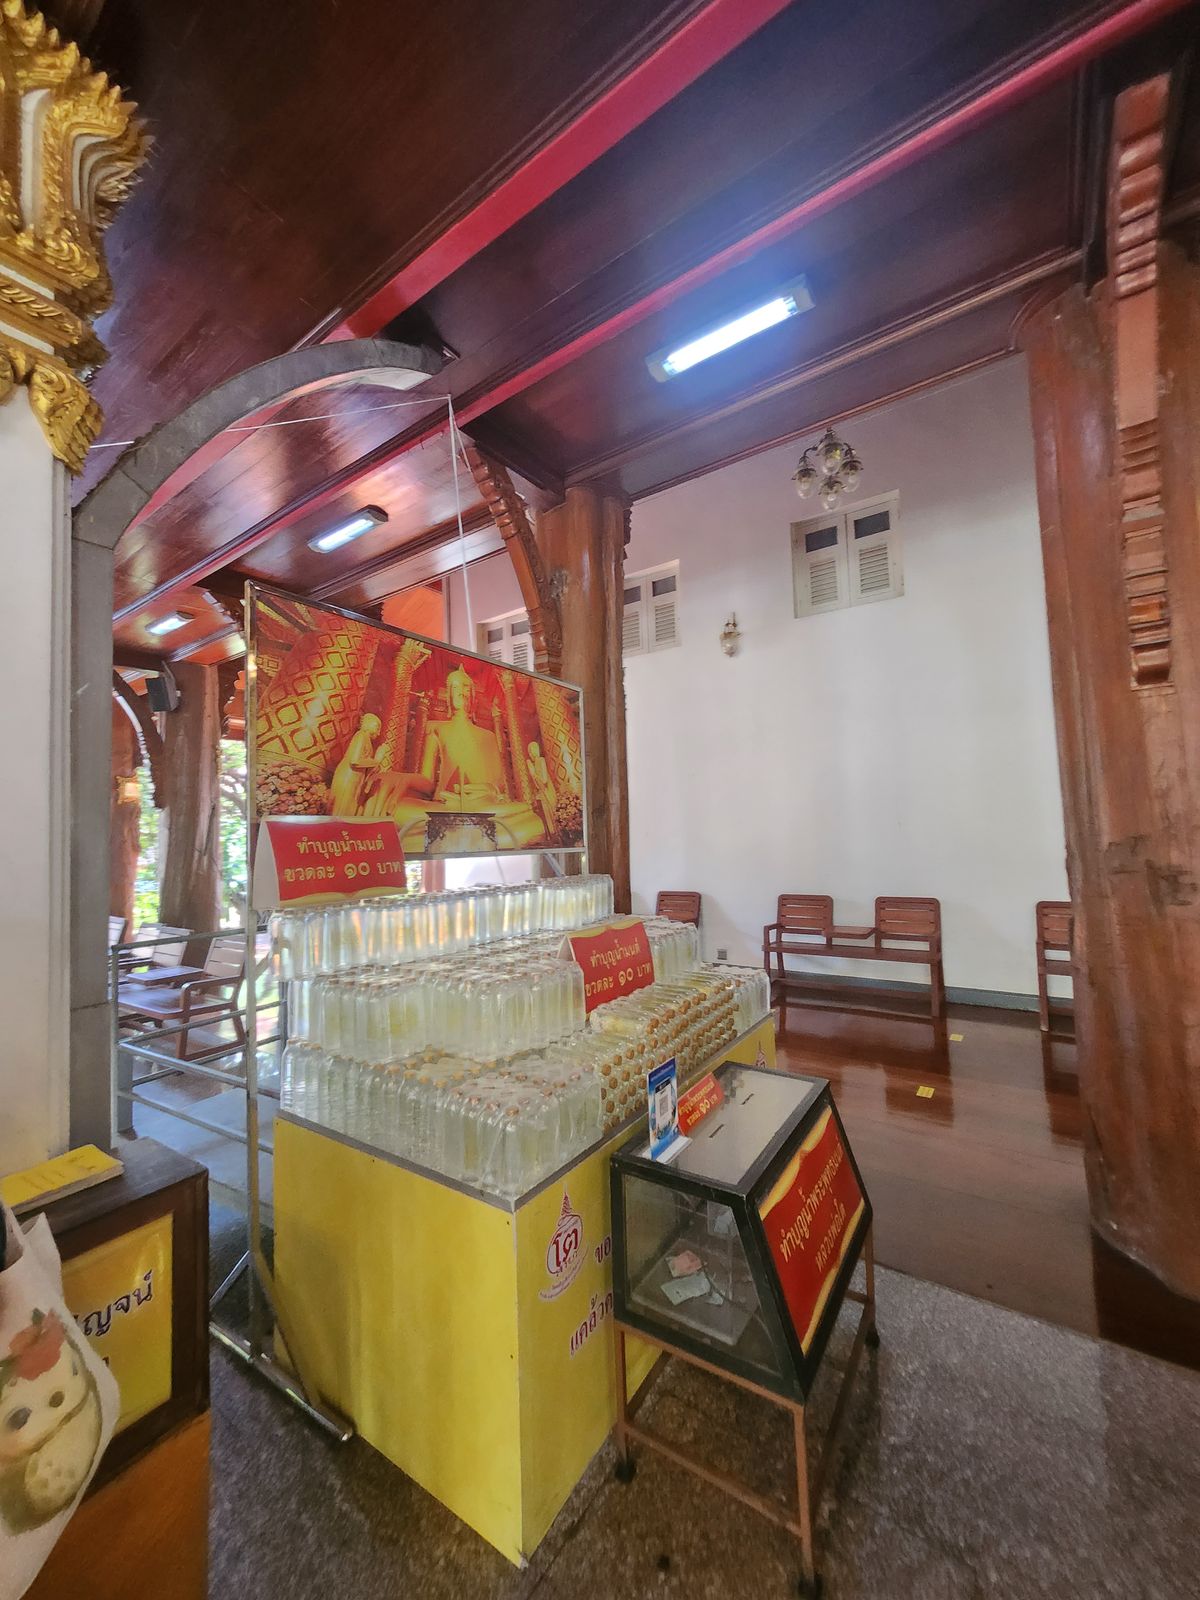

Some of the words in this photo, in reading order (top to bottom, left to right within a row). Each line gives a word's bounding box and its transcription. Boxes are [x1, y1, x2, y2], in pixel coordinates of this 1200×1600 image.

[295, 830, 385, 859] ทำบุญน้ำมนต์
[283, 864, 336, 882] ขวดละ
[344, 861, 371, 879] ๑๐
[376, 860, 402, 874] บาท
[618, 967, 634, 986] ๑๐
[73, 1269, 154, 1337] ญจน์
